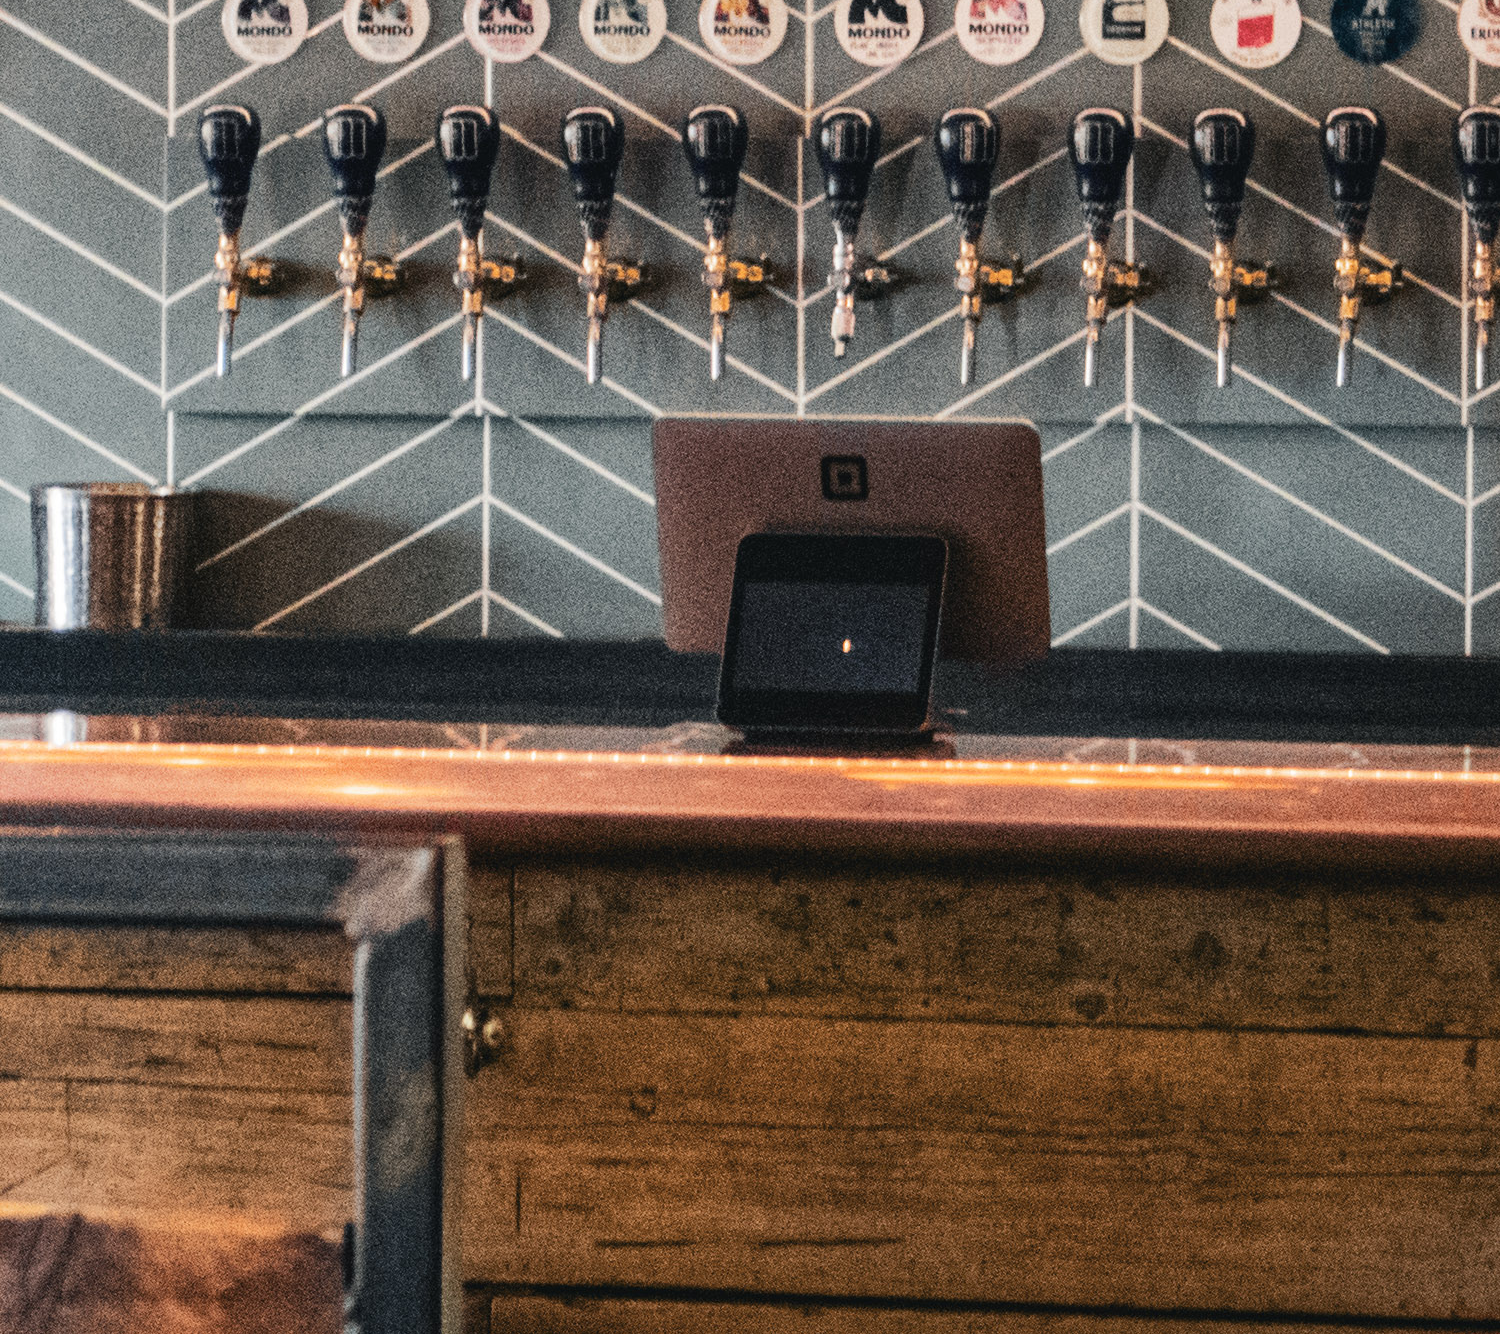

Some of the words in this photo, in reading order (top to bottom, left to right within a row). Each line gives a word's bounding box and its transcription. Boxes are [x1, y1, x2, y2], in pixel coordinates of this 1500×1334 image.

[237, 26, 292, 37] MONDO
[357, 25, 414, 36] MONDO
[479, 25, 534, 35] MONDO
[594, 25, 650, 35] MONDO
[714, 25, 770, 36] MONDO
[848, 27, 910, 38] MONDO
[969, 24, 1029, 35] MONDO
